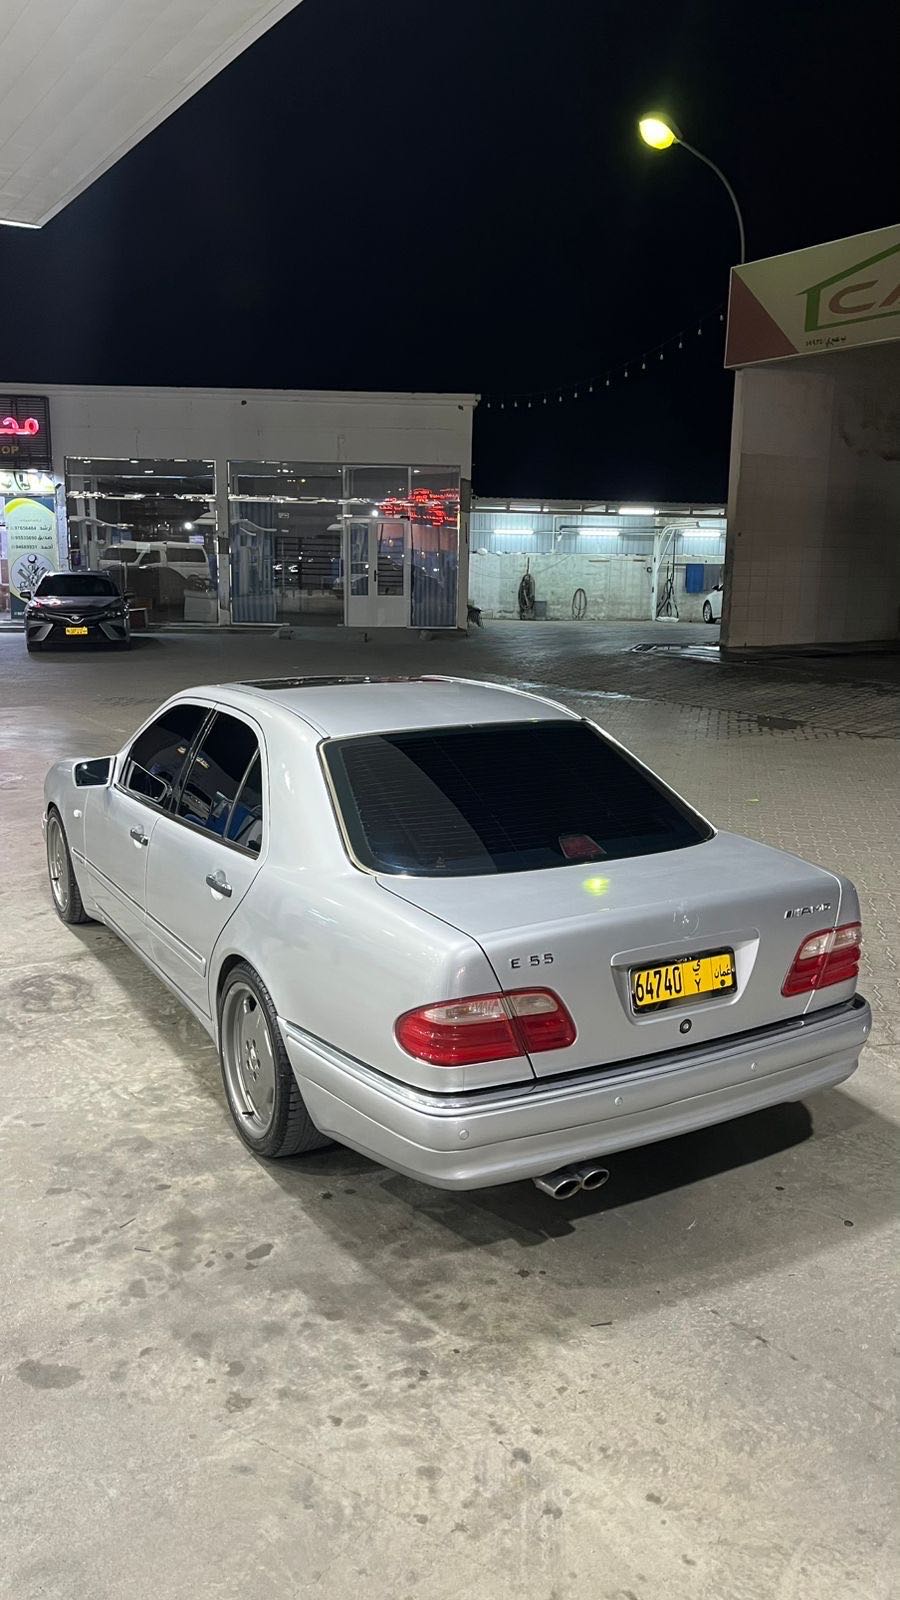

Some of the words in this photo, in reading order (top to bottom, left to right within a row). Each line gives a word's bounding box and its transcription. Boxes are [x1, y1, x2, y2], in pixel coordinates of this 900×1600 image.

[510, 958, 521, 969] E
[529, 953, 554, 966] 55
[635, 966, 683, 1003] 64740
[694, 979, 702, 992] Y
